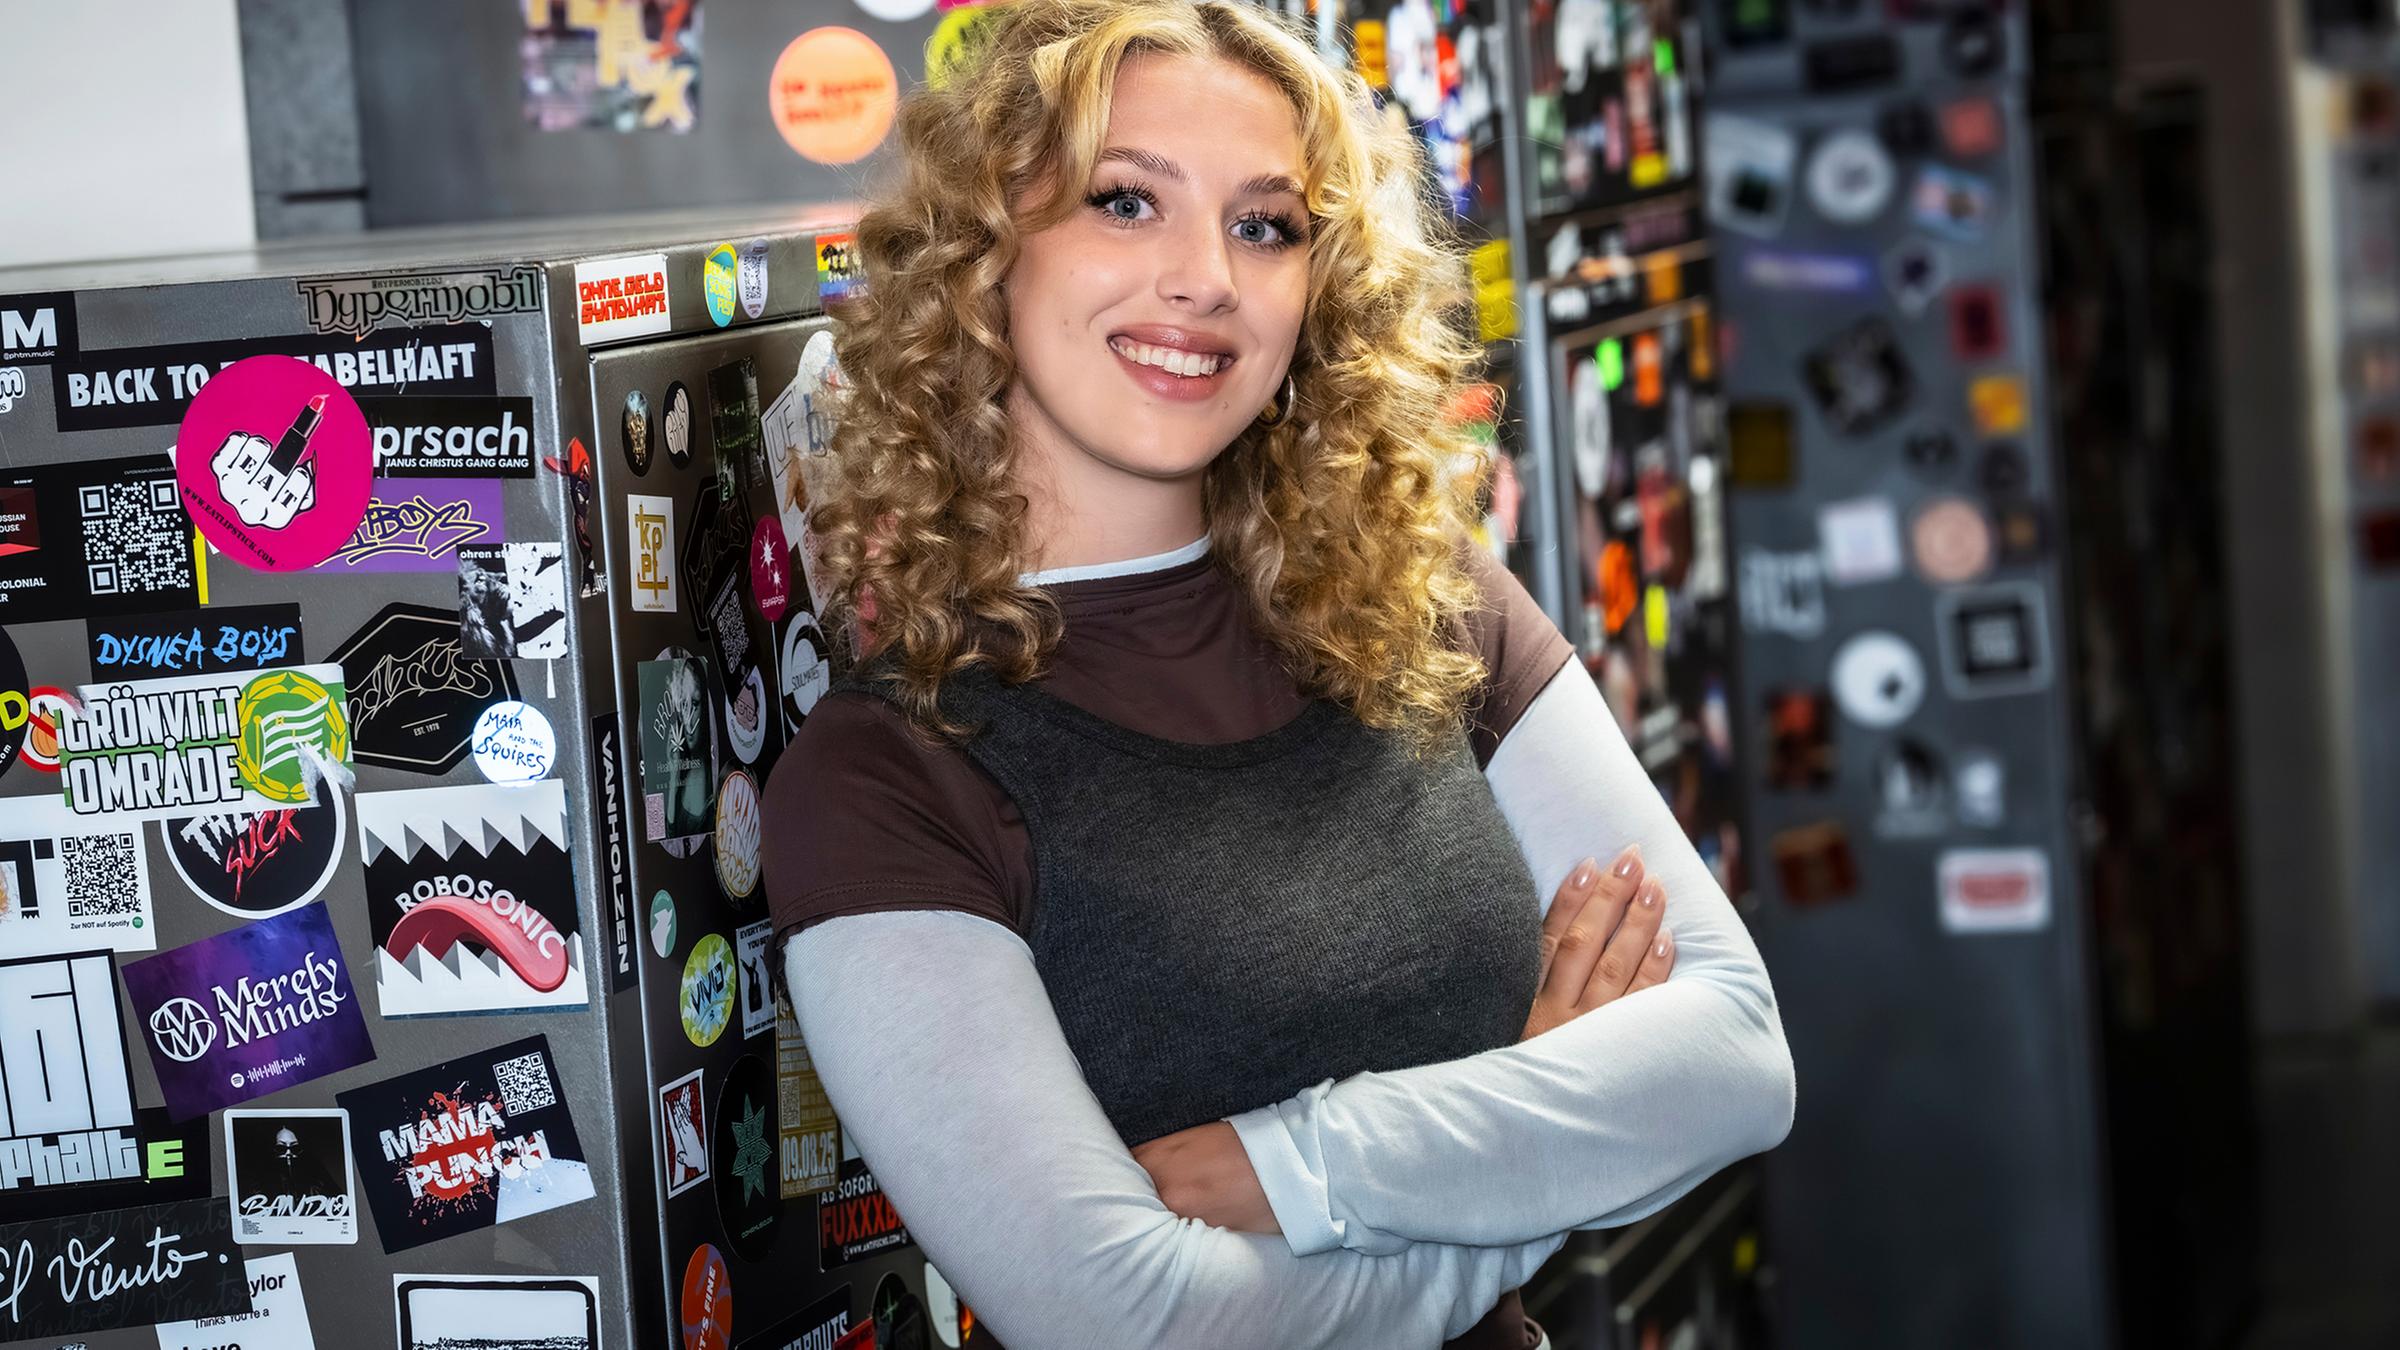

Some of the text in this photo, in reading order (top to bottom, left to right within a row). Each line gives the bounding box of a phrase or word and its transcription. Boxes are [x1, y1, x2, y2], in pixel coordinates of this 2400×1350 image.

[624, 271, 665, 297] GELD
[68, 366, 160, 408] BACK
[167, 363, 211, 400] TO
[239, 454, 298, 508] EAT
[385, 458, 529, 468] JANUS CHRISTUS GANG GANG
[183, 486, 277, 568] WWW.EATLIPSTICK.COM
[460, 550, 492, 559] ohren
[96, 625, 297, 670] DYSNEA BOYS
[60, 685, 243, 753] GRÖNVITT
[67, 735, 245, 815] OMRÅDE
[226, 809, 304, 901] SUCK
[601, 730, 629, 974] VANHOLZEN
[82, 921, 95, 929] NOT
[96, 920, 106, 928] auf
[107, 919, 130, 929] Spotify
[395, 874, 566, 960] ROBOSONIC
[211, 951, 347, 1018] Merely
[220, 986, 340, 1048] Minds
[379, 1101, 506, 1162] MAMA
[782, 1131, 836, 1182] 09.08.25
[405, 1129, 551, 1199] PUNCH
[240, 1194, 350, 1218] BANDO
[262, 1308, 270, 1317] a
[704, 1265, 716, 1313] FINE
